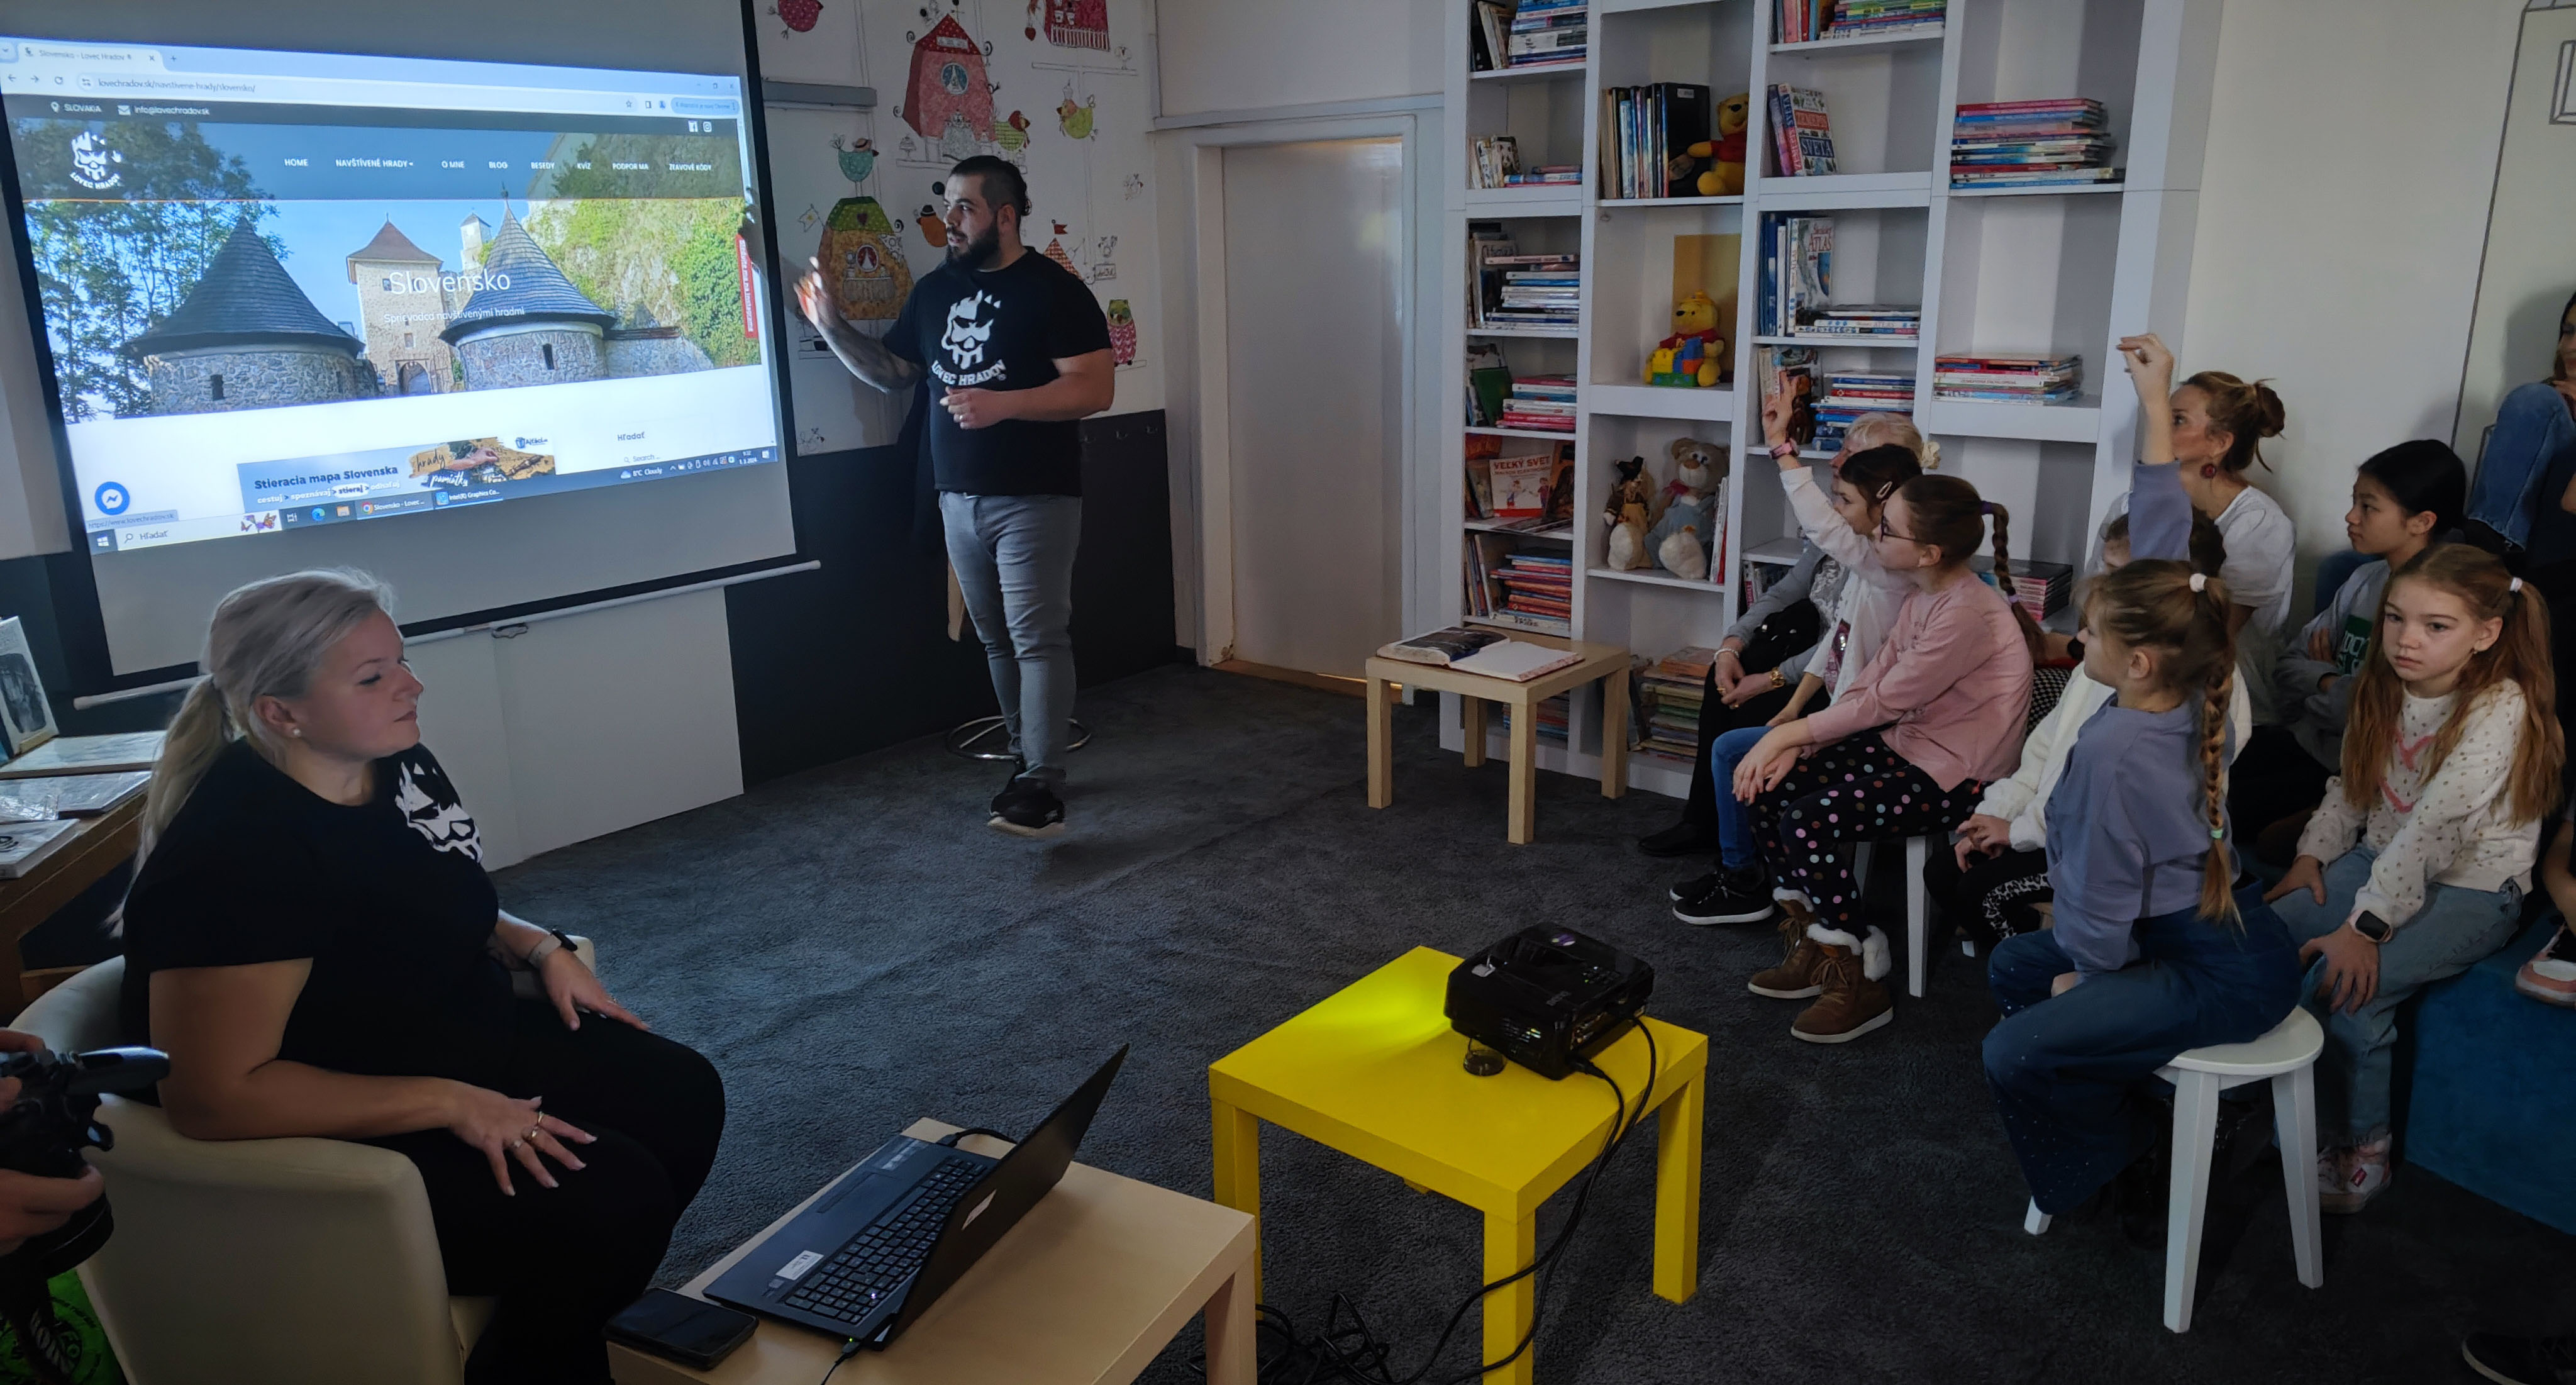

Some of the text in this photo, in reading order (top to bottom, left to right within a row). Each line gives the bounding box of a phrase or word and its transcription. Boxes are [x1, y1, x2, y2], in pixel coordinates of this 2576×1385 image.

[64, 103, 102, 113] SLOVAKIA
[284, 159, 308, 167] HOME
[382, 160, 408, 168] HRADY
[449, 160, 465, 169] MNE
[489, 161, 508, 169] BLOG
[531, 162, 555, 170] BESEDY
[69, 172, 94, 189] LOVEC
[389, 268, 511, 294] Slovensko
[384, 313, 435, 323] Sprievodca
[494, 306, 525, 316] hradmi
[931, 359, 1006, 386] LOVEC HRADOV
[416, 448, 445, 471] hrady
[633, 453, 655, 462] Search
[1526, 456, 1550, 467] SVET
[254, 465, 398, 489] Stieracia mapa Slovenska
[644, 467, 662, 476] Cloudy
[257, 493, 284, 504] cestuj
[291, 487, 331, 501] spoznávaj
[338, 484, 364, 494] stieraj
[467, 491, 489, 501] Graphics
[140, 530, 169, 540] Hľadať
